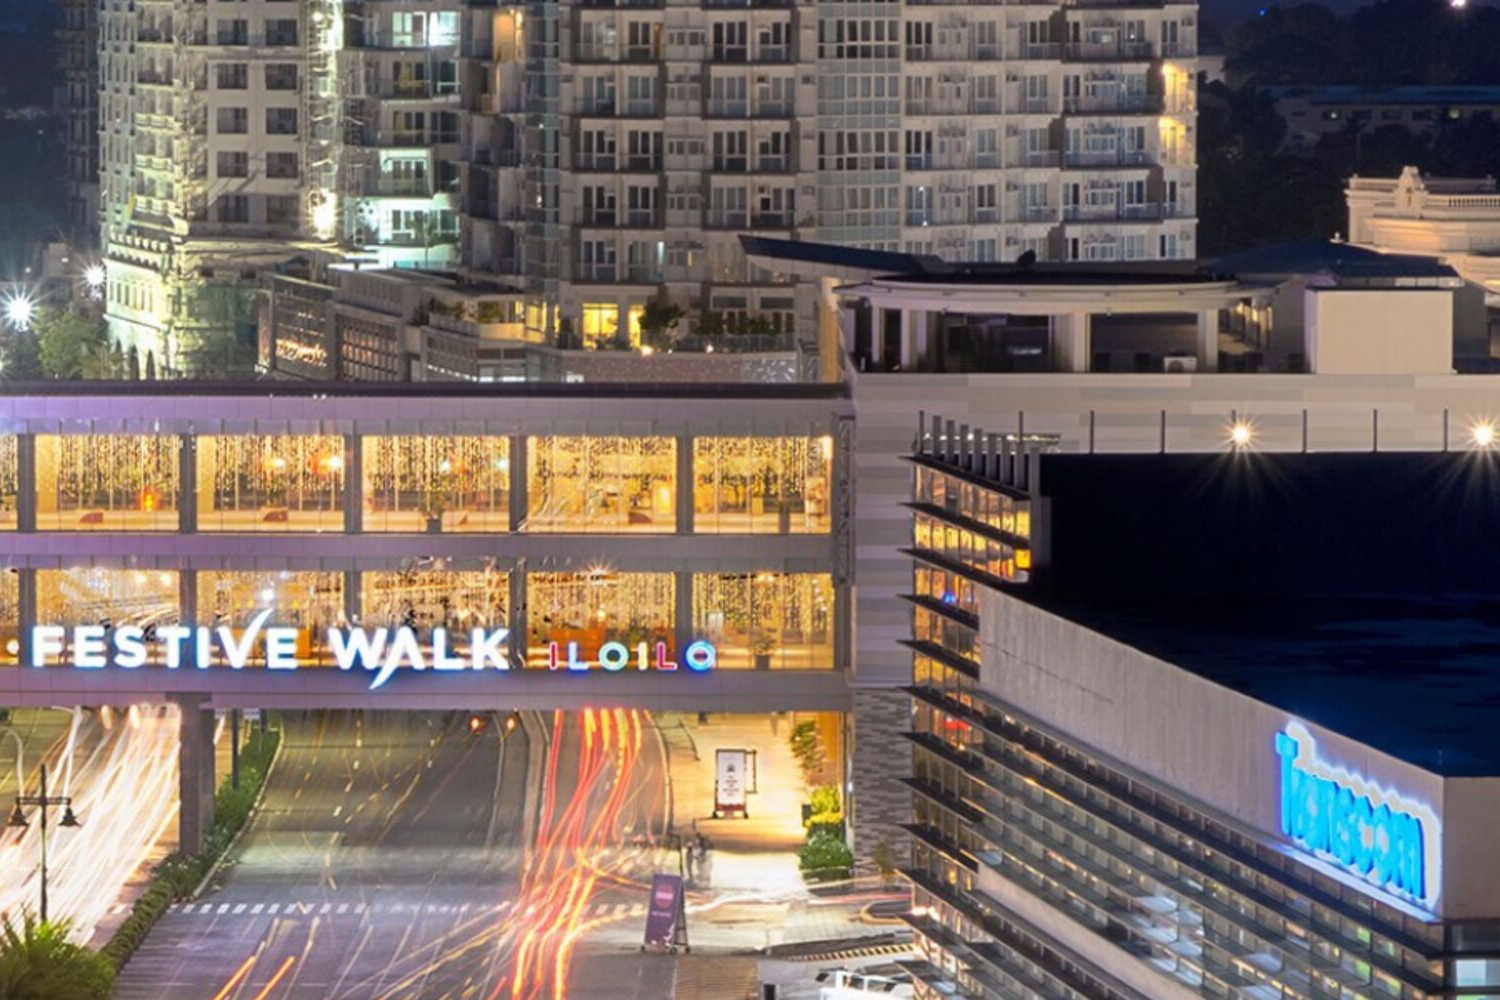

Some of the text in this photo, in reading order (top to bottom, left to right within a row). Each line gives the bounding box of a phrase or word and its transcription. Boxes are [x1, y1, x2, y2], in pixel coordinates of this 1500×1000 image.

[32, 608, 717, 690] FESTIVE WALK ILOILO
